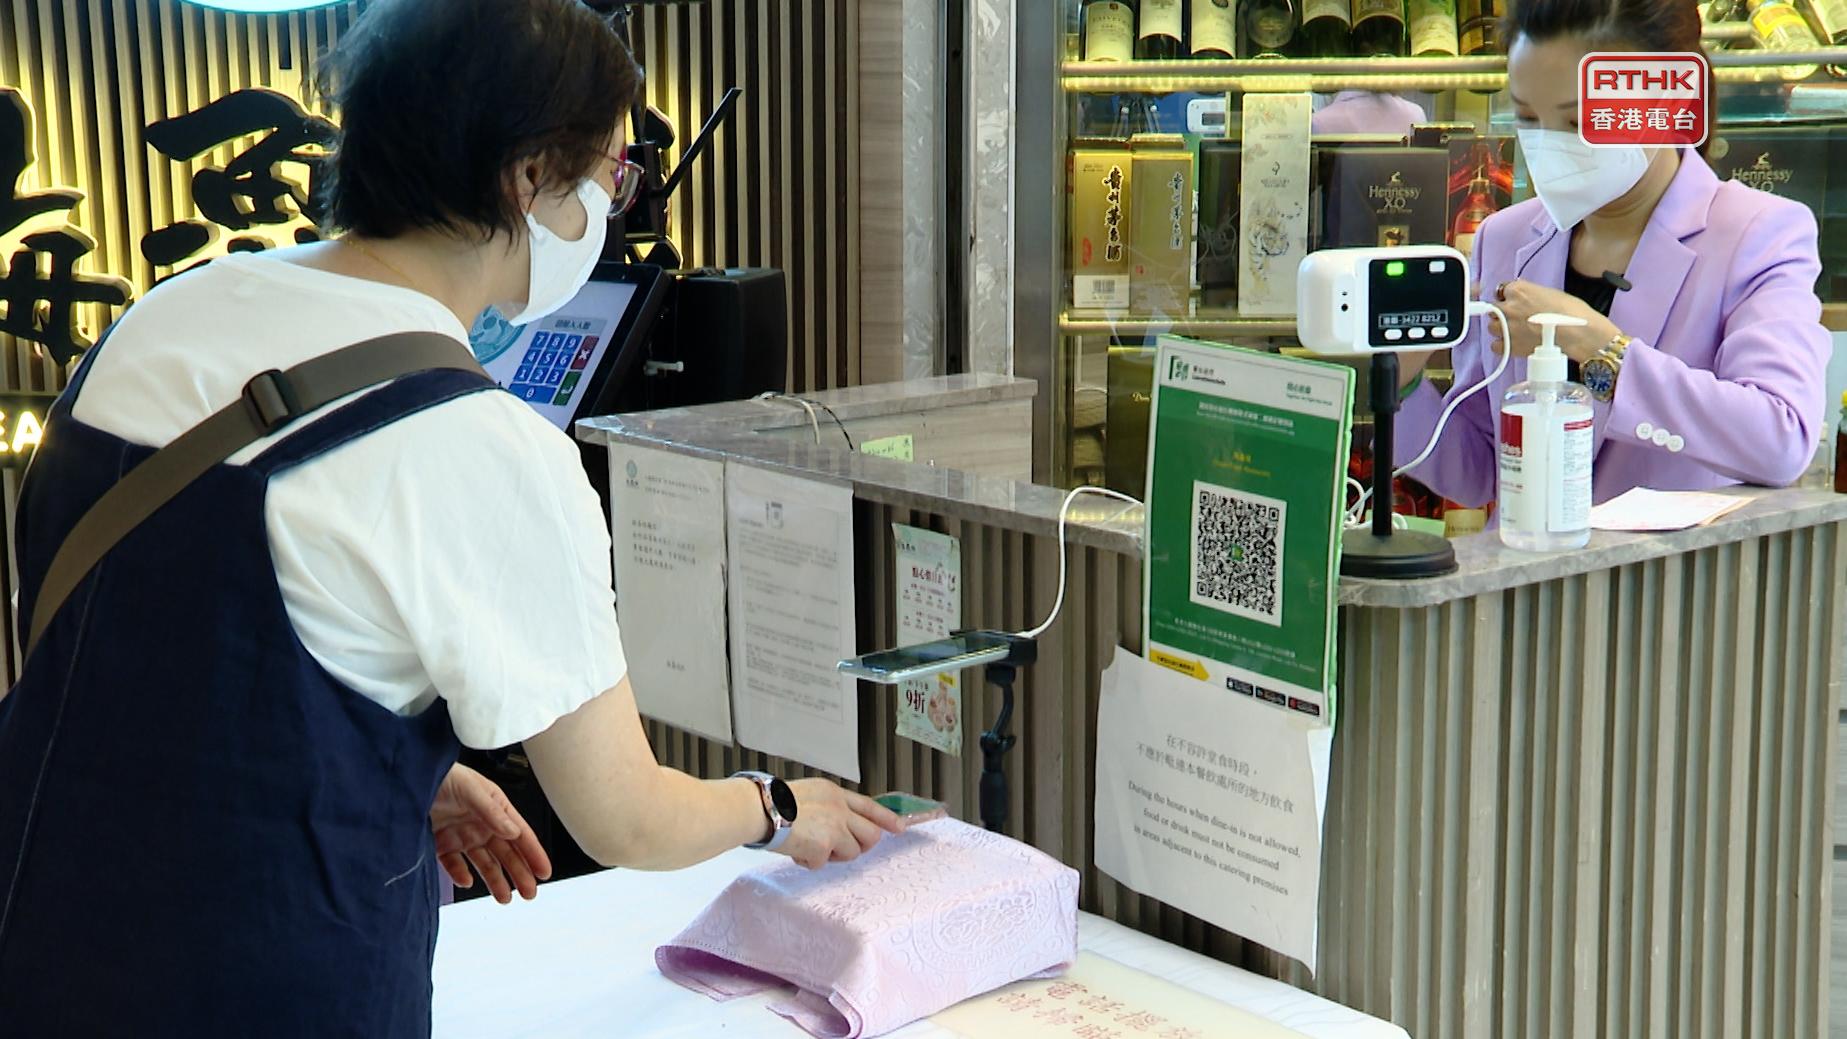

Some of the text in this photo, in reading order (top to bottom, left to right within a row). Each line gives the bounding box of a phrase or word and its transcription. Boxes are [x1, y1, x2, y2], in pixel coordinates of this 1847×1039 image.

[1731, 166, 1793, 183] Hennessy
[1368, 184, 1421, 200] Hennessy
[536, 335, 577, 347] 7 8 9
[528, 351, 569, 366] 4 5 6
[519, 369, 560, 382] 1 2 3
[526, 387, 535, 398] 0
[1128, 779, 1152, 801] During
[1154, 792, 1165, 804] the
[1166, 796, 1187, 814] hours
[1189, 807, 1209, 822] when
[1210, 816, 1238, 834] dine-in
[1248, 833, 1262, 844] not
[1144, 807, 1280, 871] food or drink must not be consumed
[1142, 829, 1160, 842] areas
[1162, 837, 1193, 856] adjacent
[1194, 850, 1202, 860] to
[1203, 854, 1217, 867] this
[1219, 862, 1251, 883] catering
[1252, 875, 1289, 896] premises
